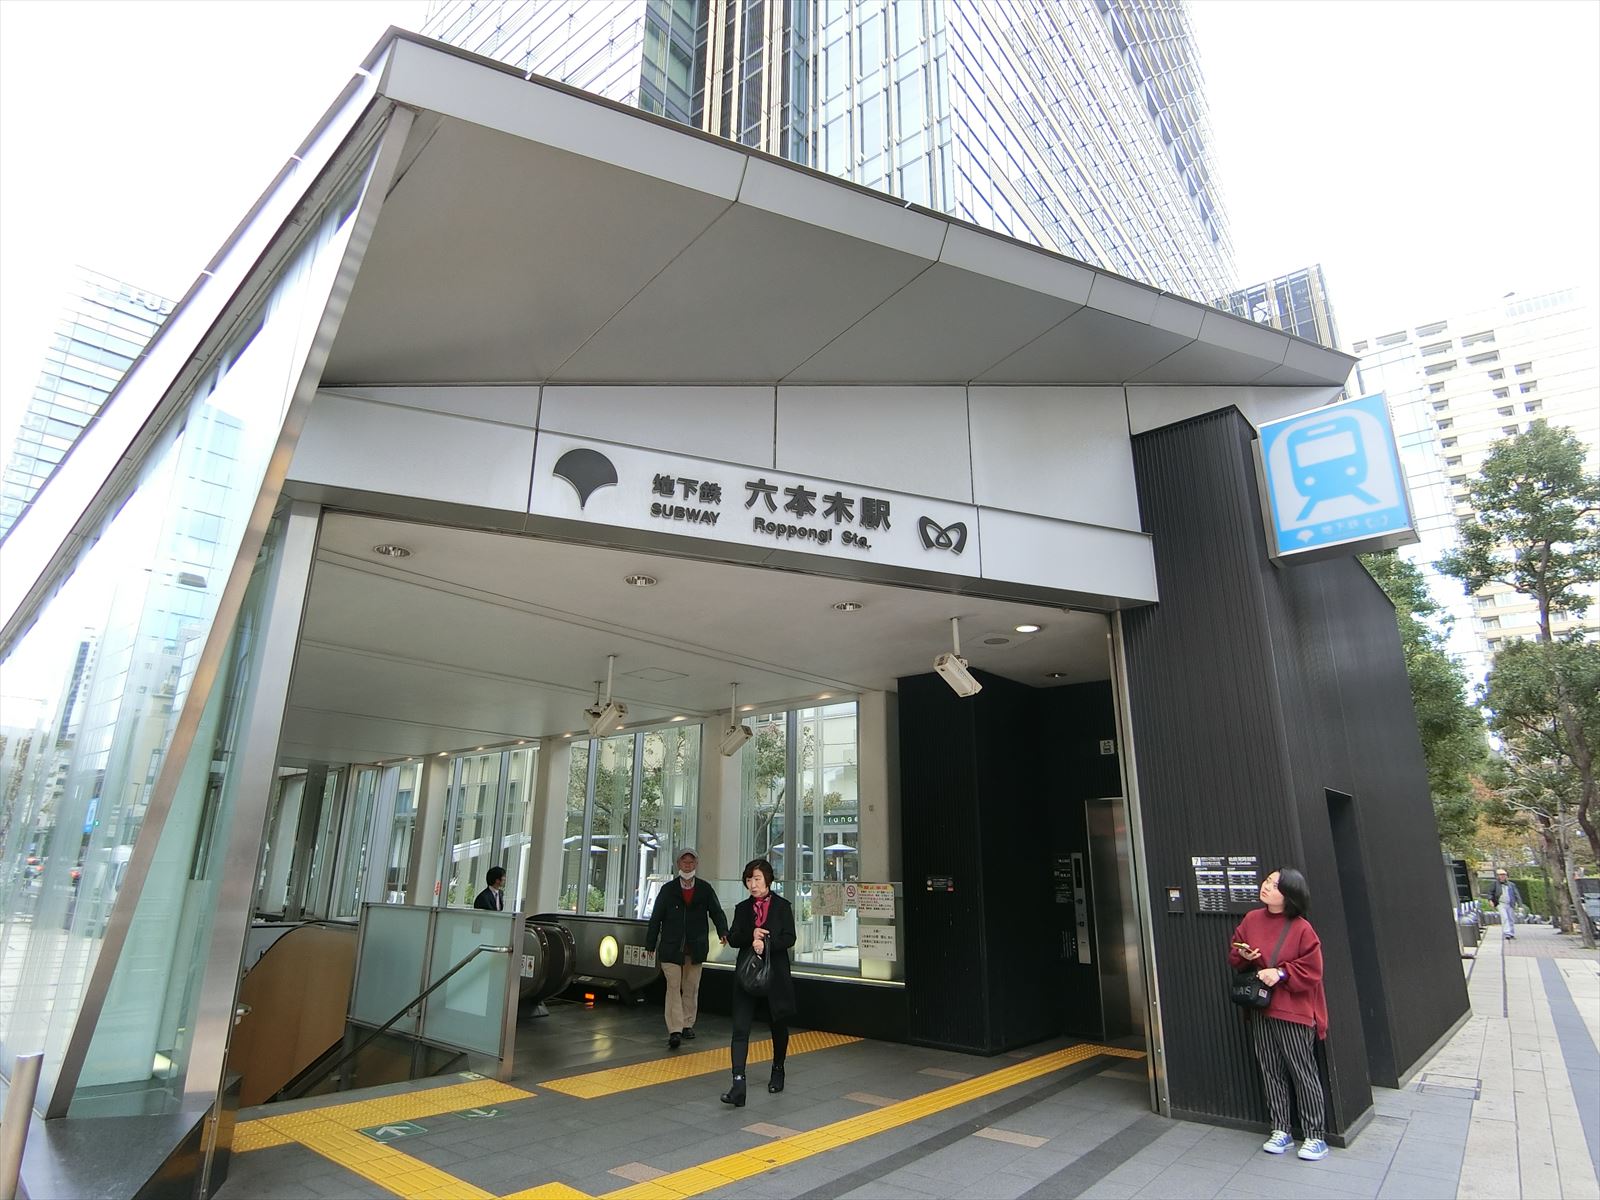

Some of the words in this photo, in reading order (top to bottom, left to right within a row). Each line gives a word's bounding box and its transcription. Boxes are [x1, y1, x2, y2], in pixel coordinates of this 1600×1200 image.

[650, 502, 721, 526] SUBWAY
[652, 473, 722, 505] 地下鉄
[744, 478, 892, 531] 六本木駅
[753, 516, 833, 545] Roppongi
[841, 530, 872, 549] Sta.
